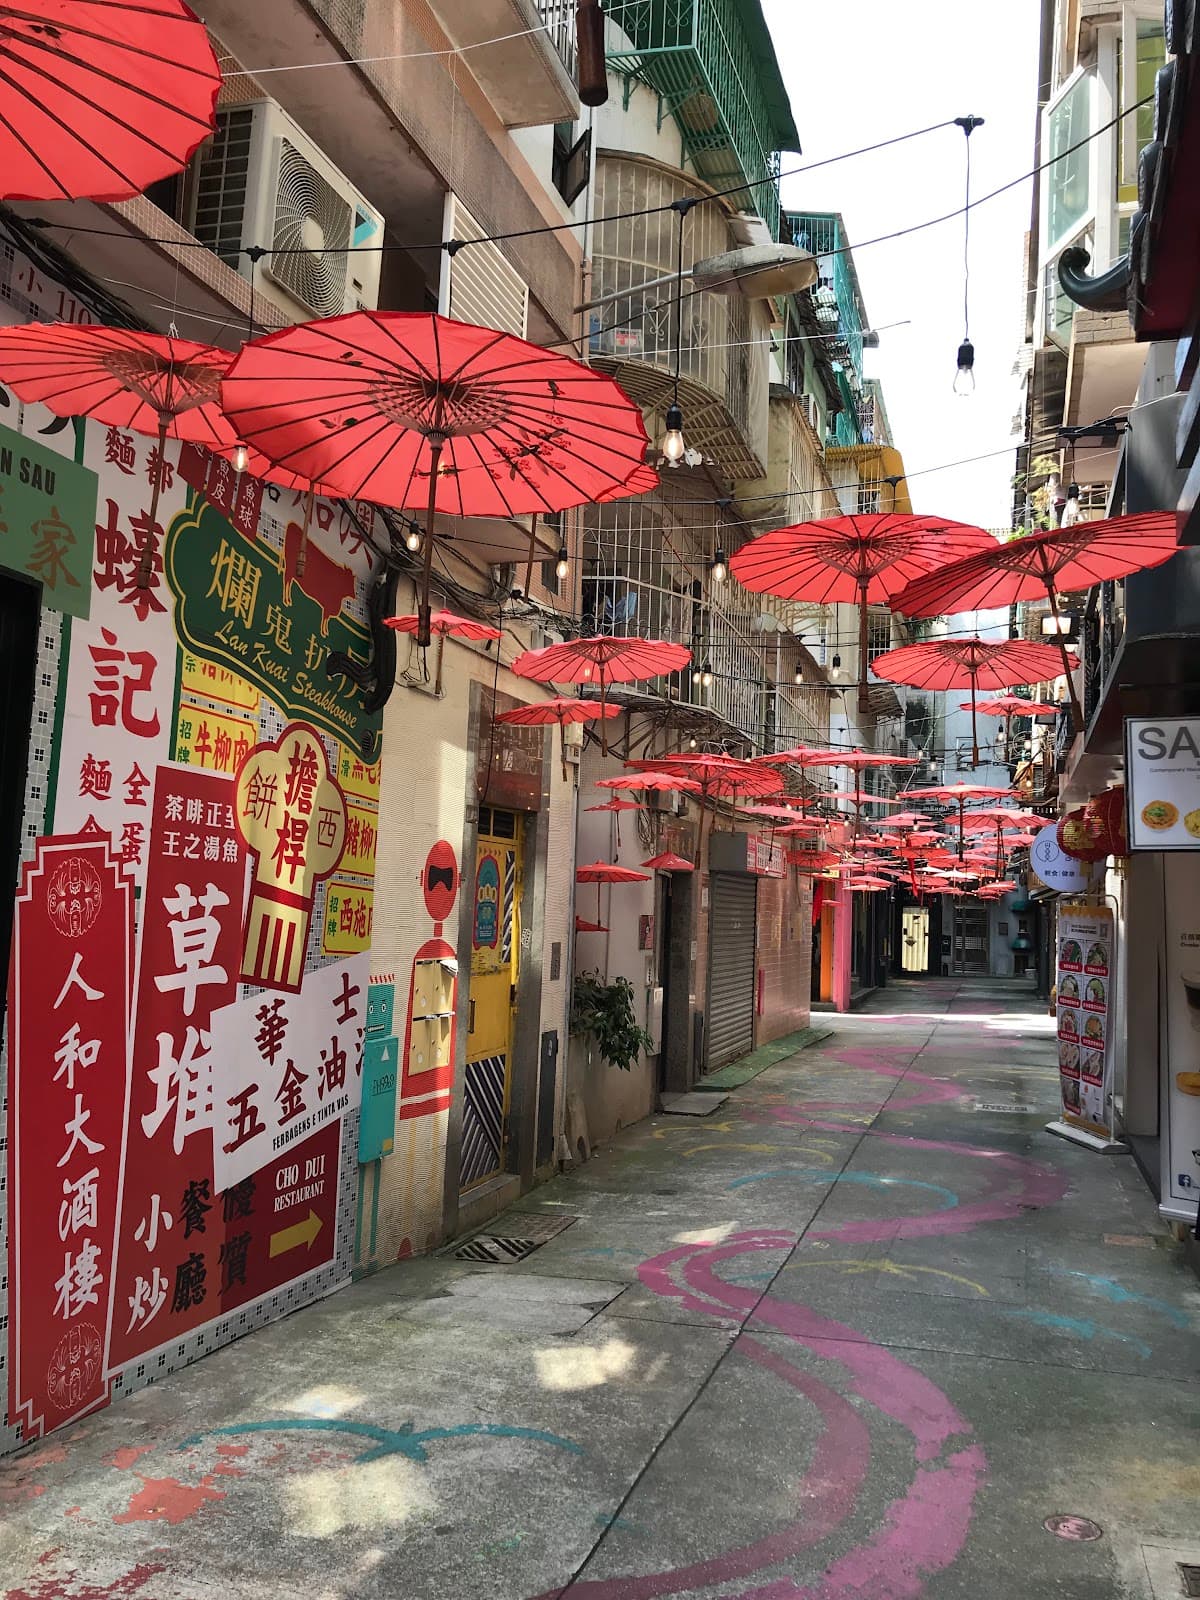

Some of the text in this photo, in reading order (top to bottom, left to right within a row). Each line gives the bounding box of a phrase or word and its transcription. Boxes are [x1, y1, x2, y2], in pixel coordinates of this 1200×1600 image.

[19, 456, 56, 497] SAU
[214, 620, 249, 656] Lan
[252, 642, 290, 683] Kuai
[291, 671, 358, 730] Steakhouse
[242, 765, 278, 829] 餅
[317, 806, 341, 849] 西
[345, 816, 378, 861] 豬柳
[52, 952, 106, 1321] 人和大酒樓
[312, 1113, 316, 1126] E
[275, 1154, 326, 1191] CHO DUI
[273, 1180, 325, 1213] RESTAURANT
[124, 1194, 173, 1336] 小炒
